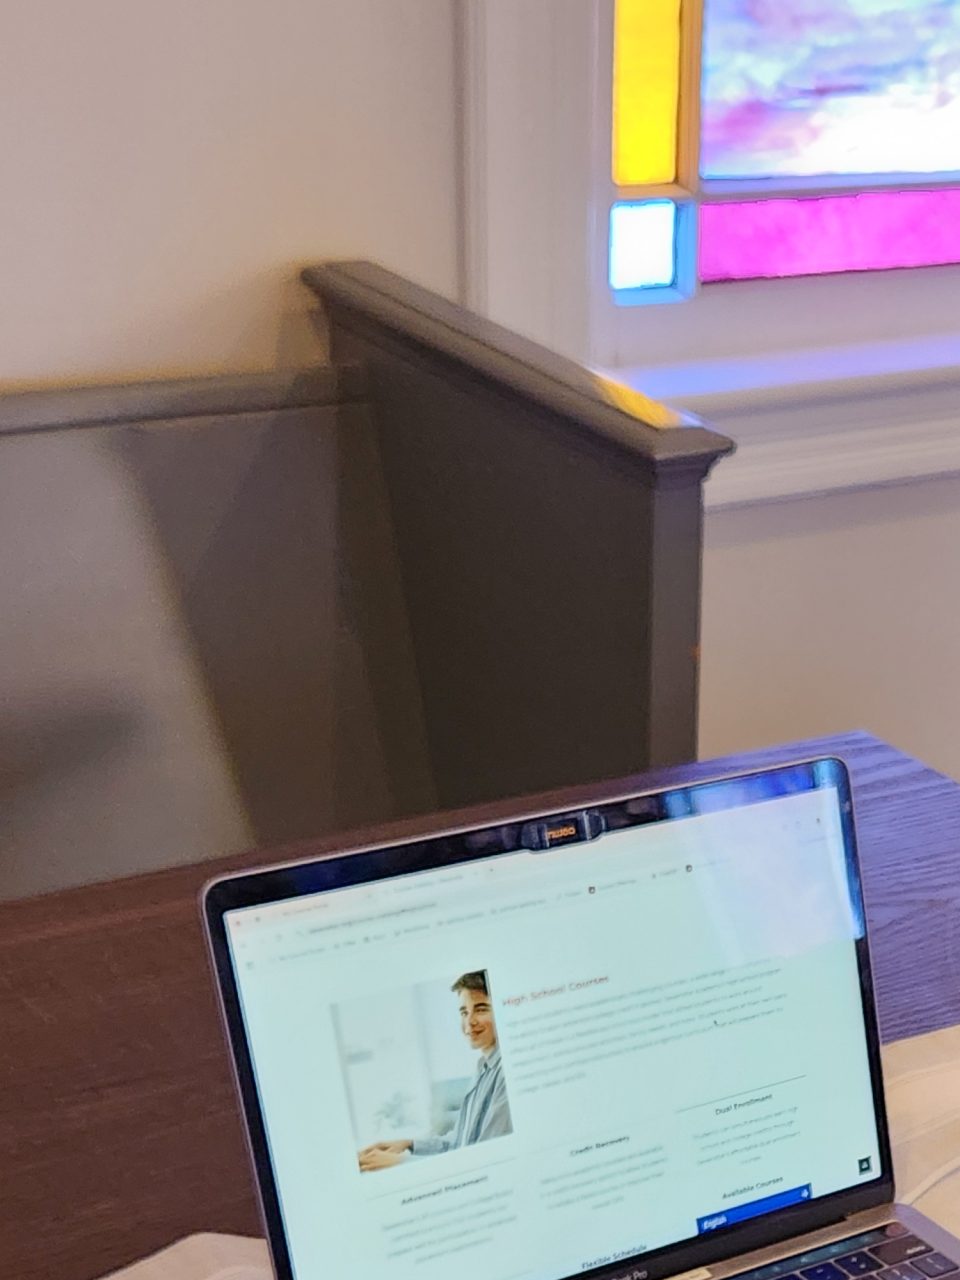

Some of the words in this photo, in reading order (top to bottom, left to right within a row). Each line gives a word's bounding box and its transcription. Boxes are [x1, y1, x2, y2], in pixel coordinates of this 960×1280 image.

[502, 995, 528, 1008] High
[530, 986, 565, 1001] School
[569, 976, 610, 991] Courses
[715, 1105, 732, 1115] Dual
[733, 1093, 773, 1110] Enrollment
[722, 1185, 755, 1200] Available
[756, 1176, 784, 1190] Courses
[581, 1255, 611, 1270] Flexible
[612, 1244, 648, 1261] Schedule
